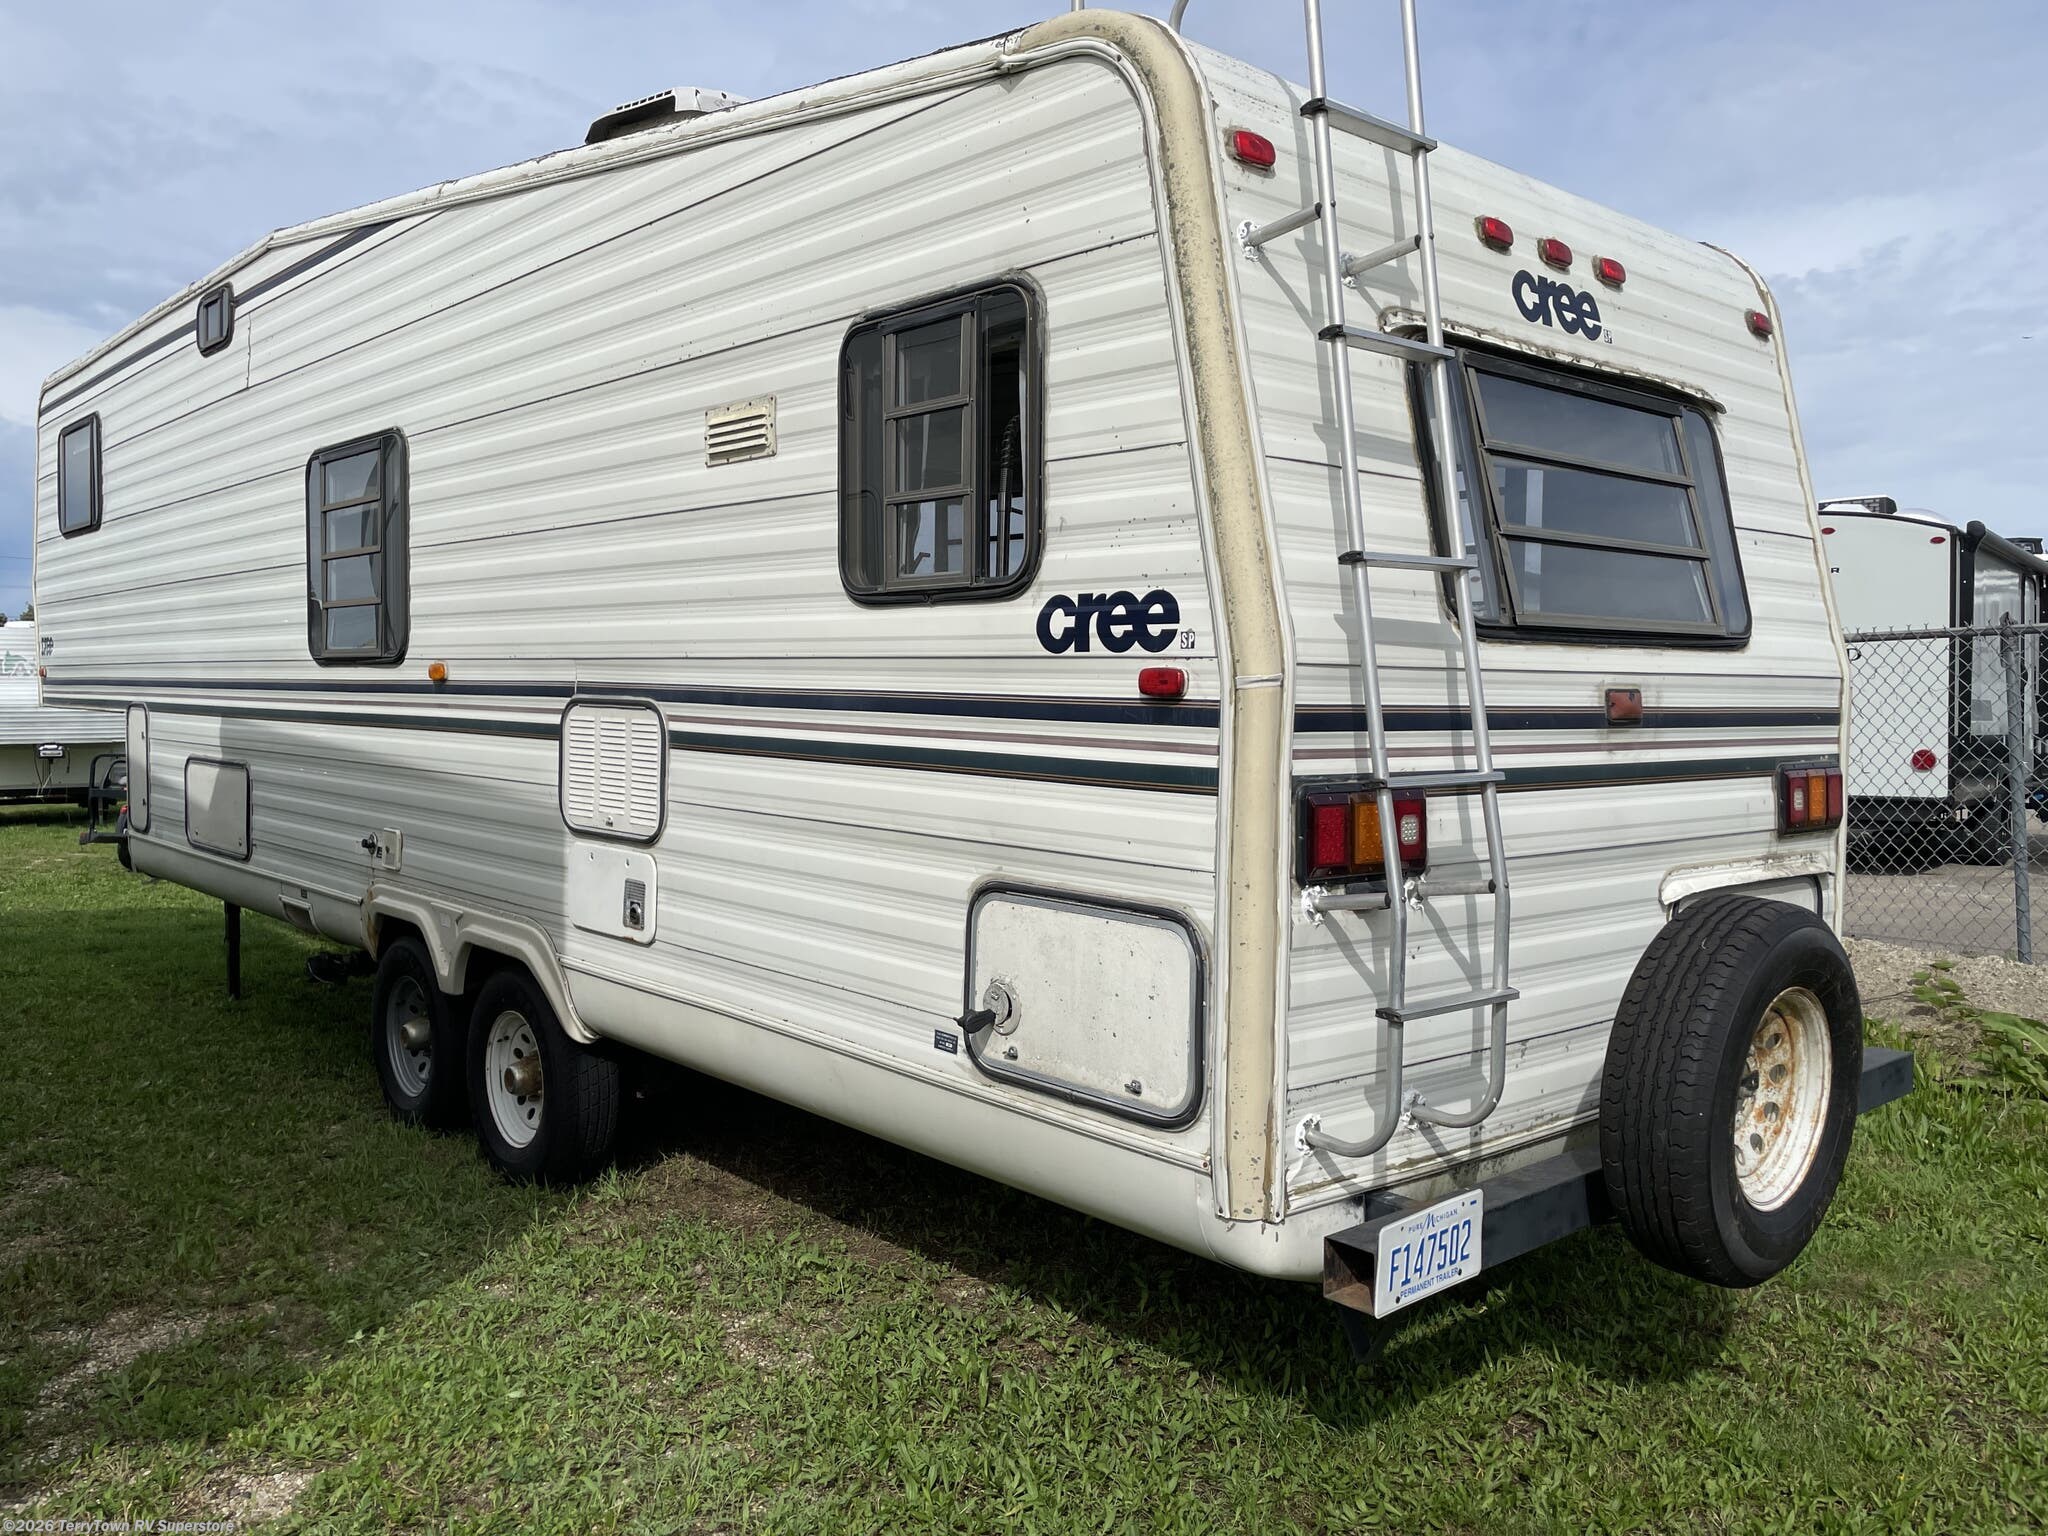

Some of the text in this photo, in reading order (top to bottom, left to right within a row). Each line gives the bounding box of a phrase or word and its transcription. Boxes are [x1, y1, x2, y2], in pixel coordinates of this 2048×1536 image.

[1180, 631, 1195, 649] SP
[1389, 1219, 1471, 1292] F147502
[1400, 1267, 1459, 1298] PERMANENT TRAILER
